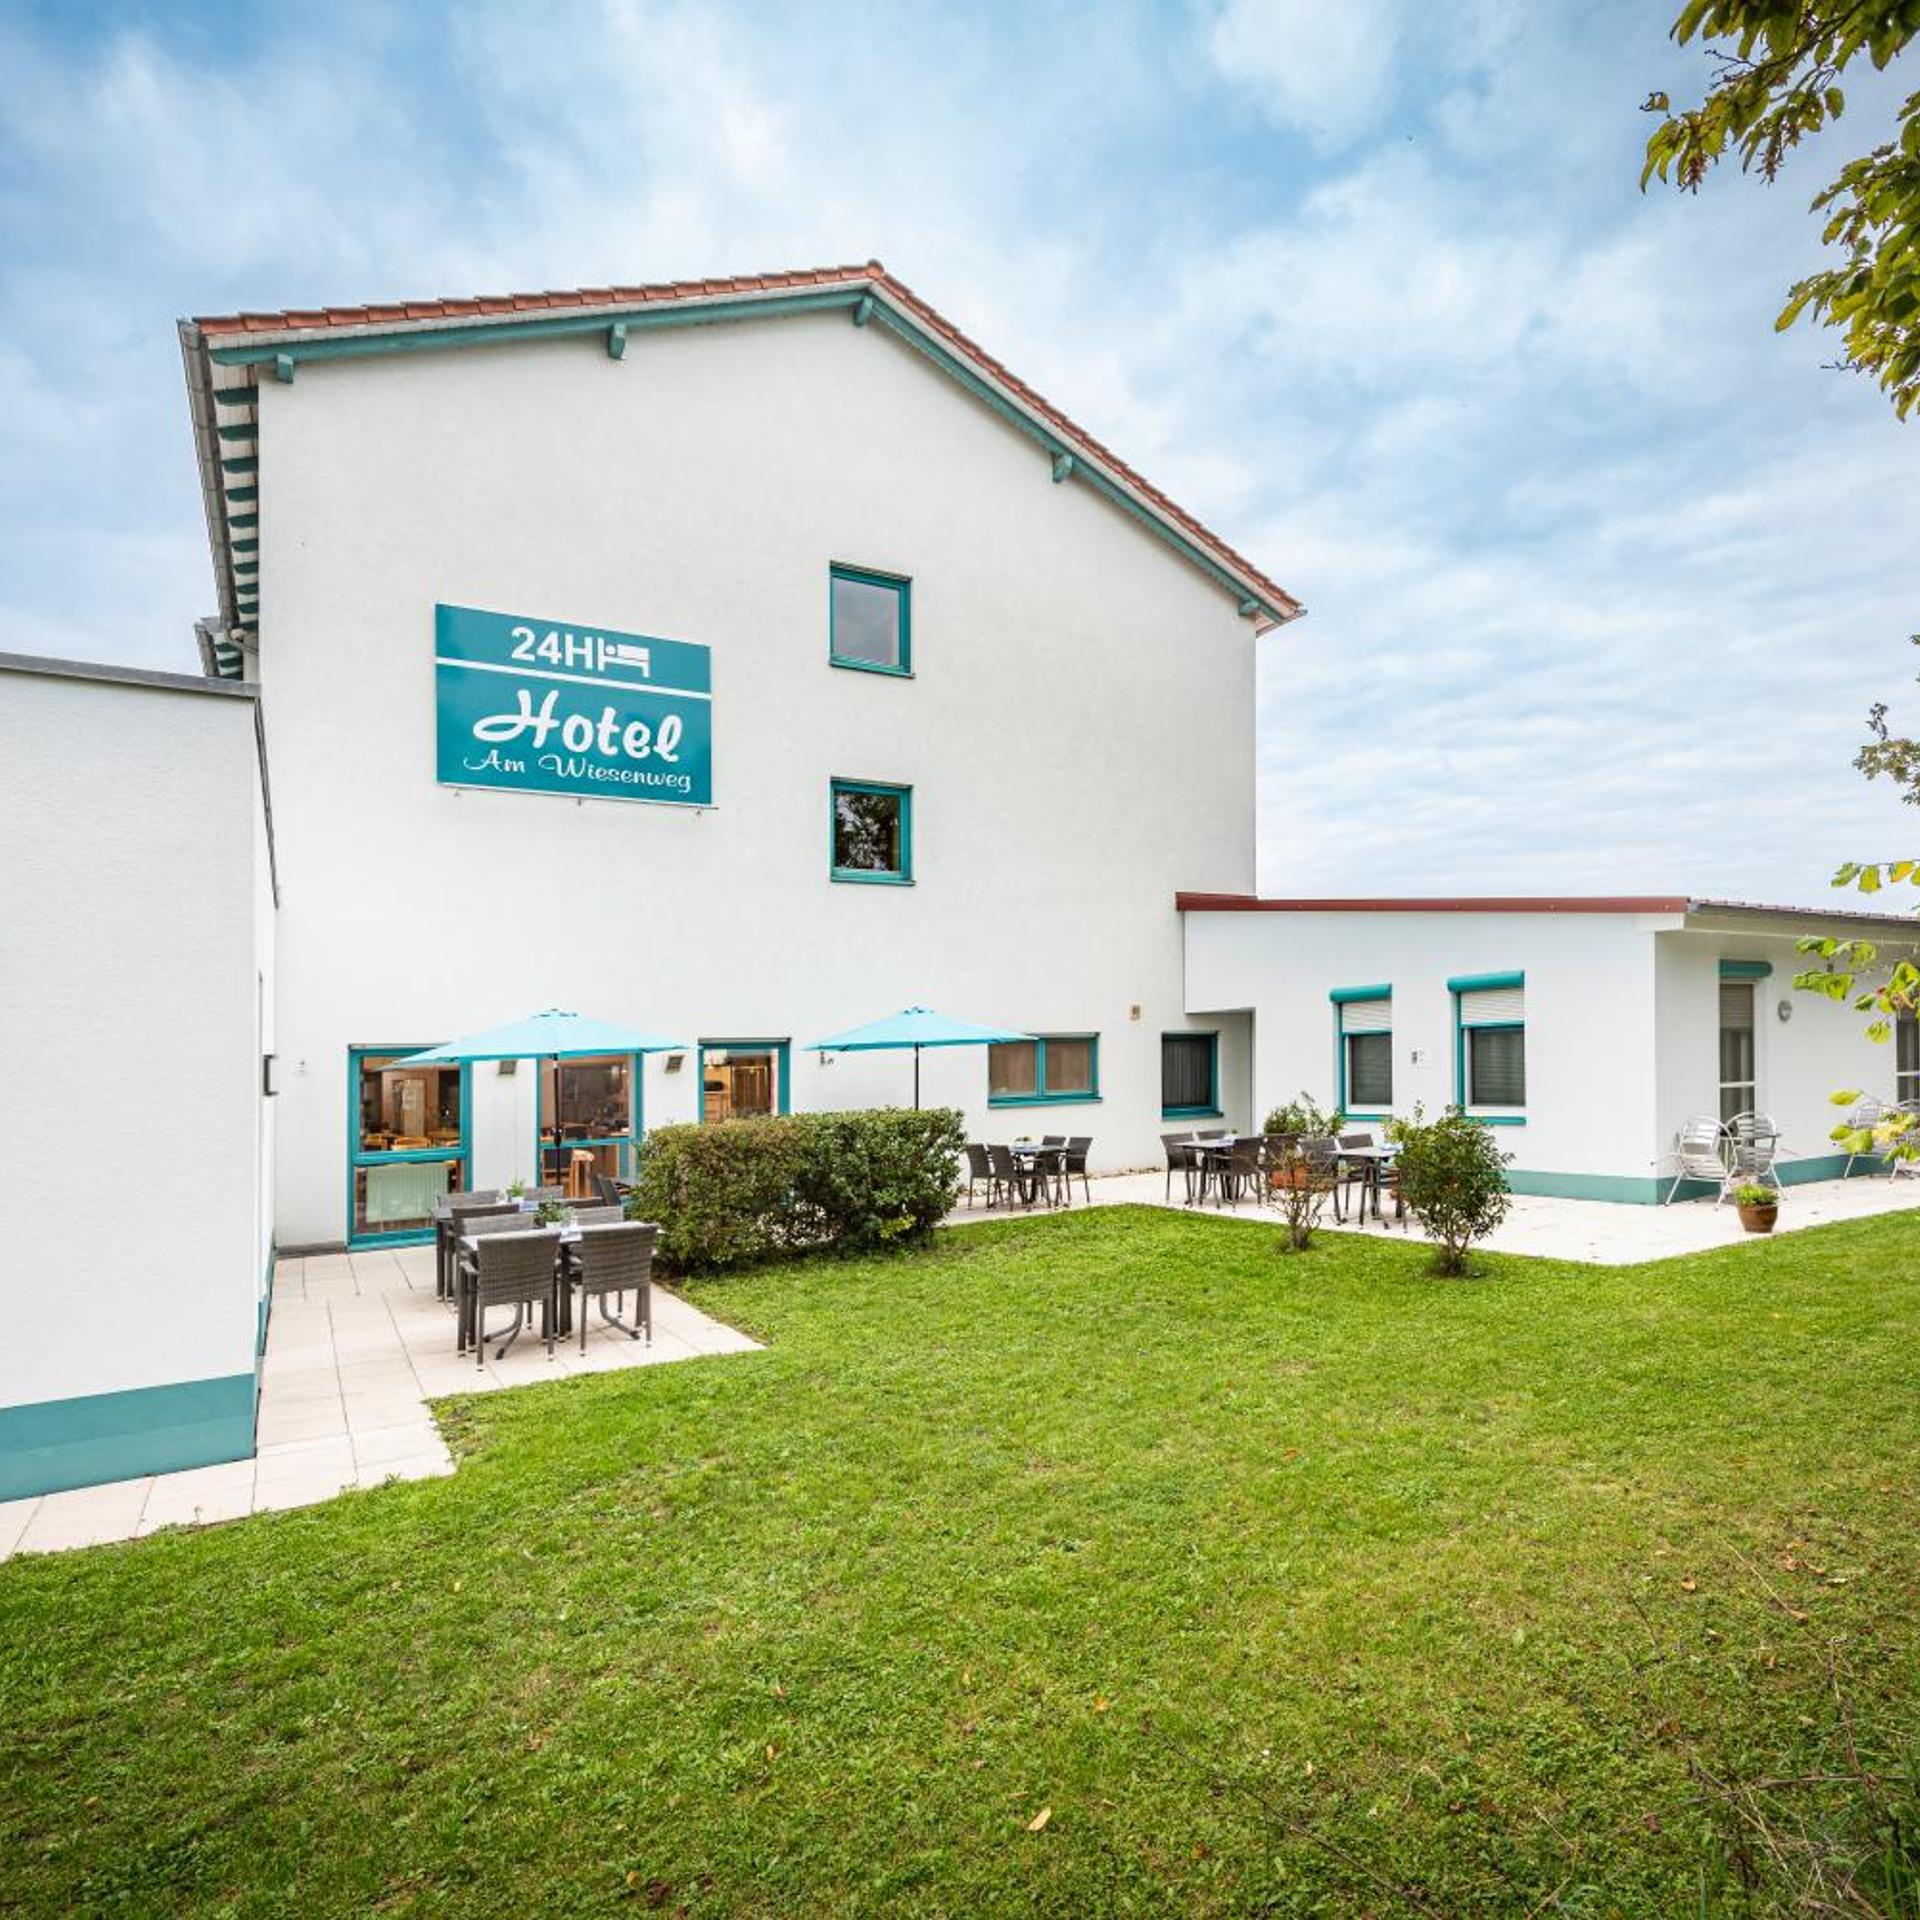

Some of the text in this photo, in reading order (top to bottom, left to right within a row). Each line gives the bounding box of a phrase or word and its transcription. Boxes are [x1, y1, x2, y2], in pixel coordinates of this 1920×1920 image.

[511, 626, 593, 669] 24H
[473, 689, 682, 762] Hotel
[463, 749, 691, 793] Am Wiesenweg
